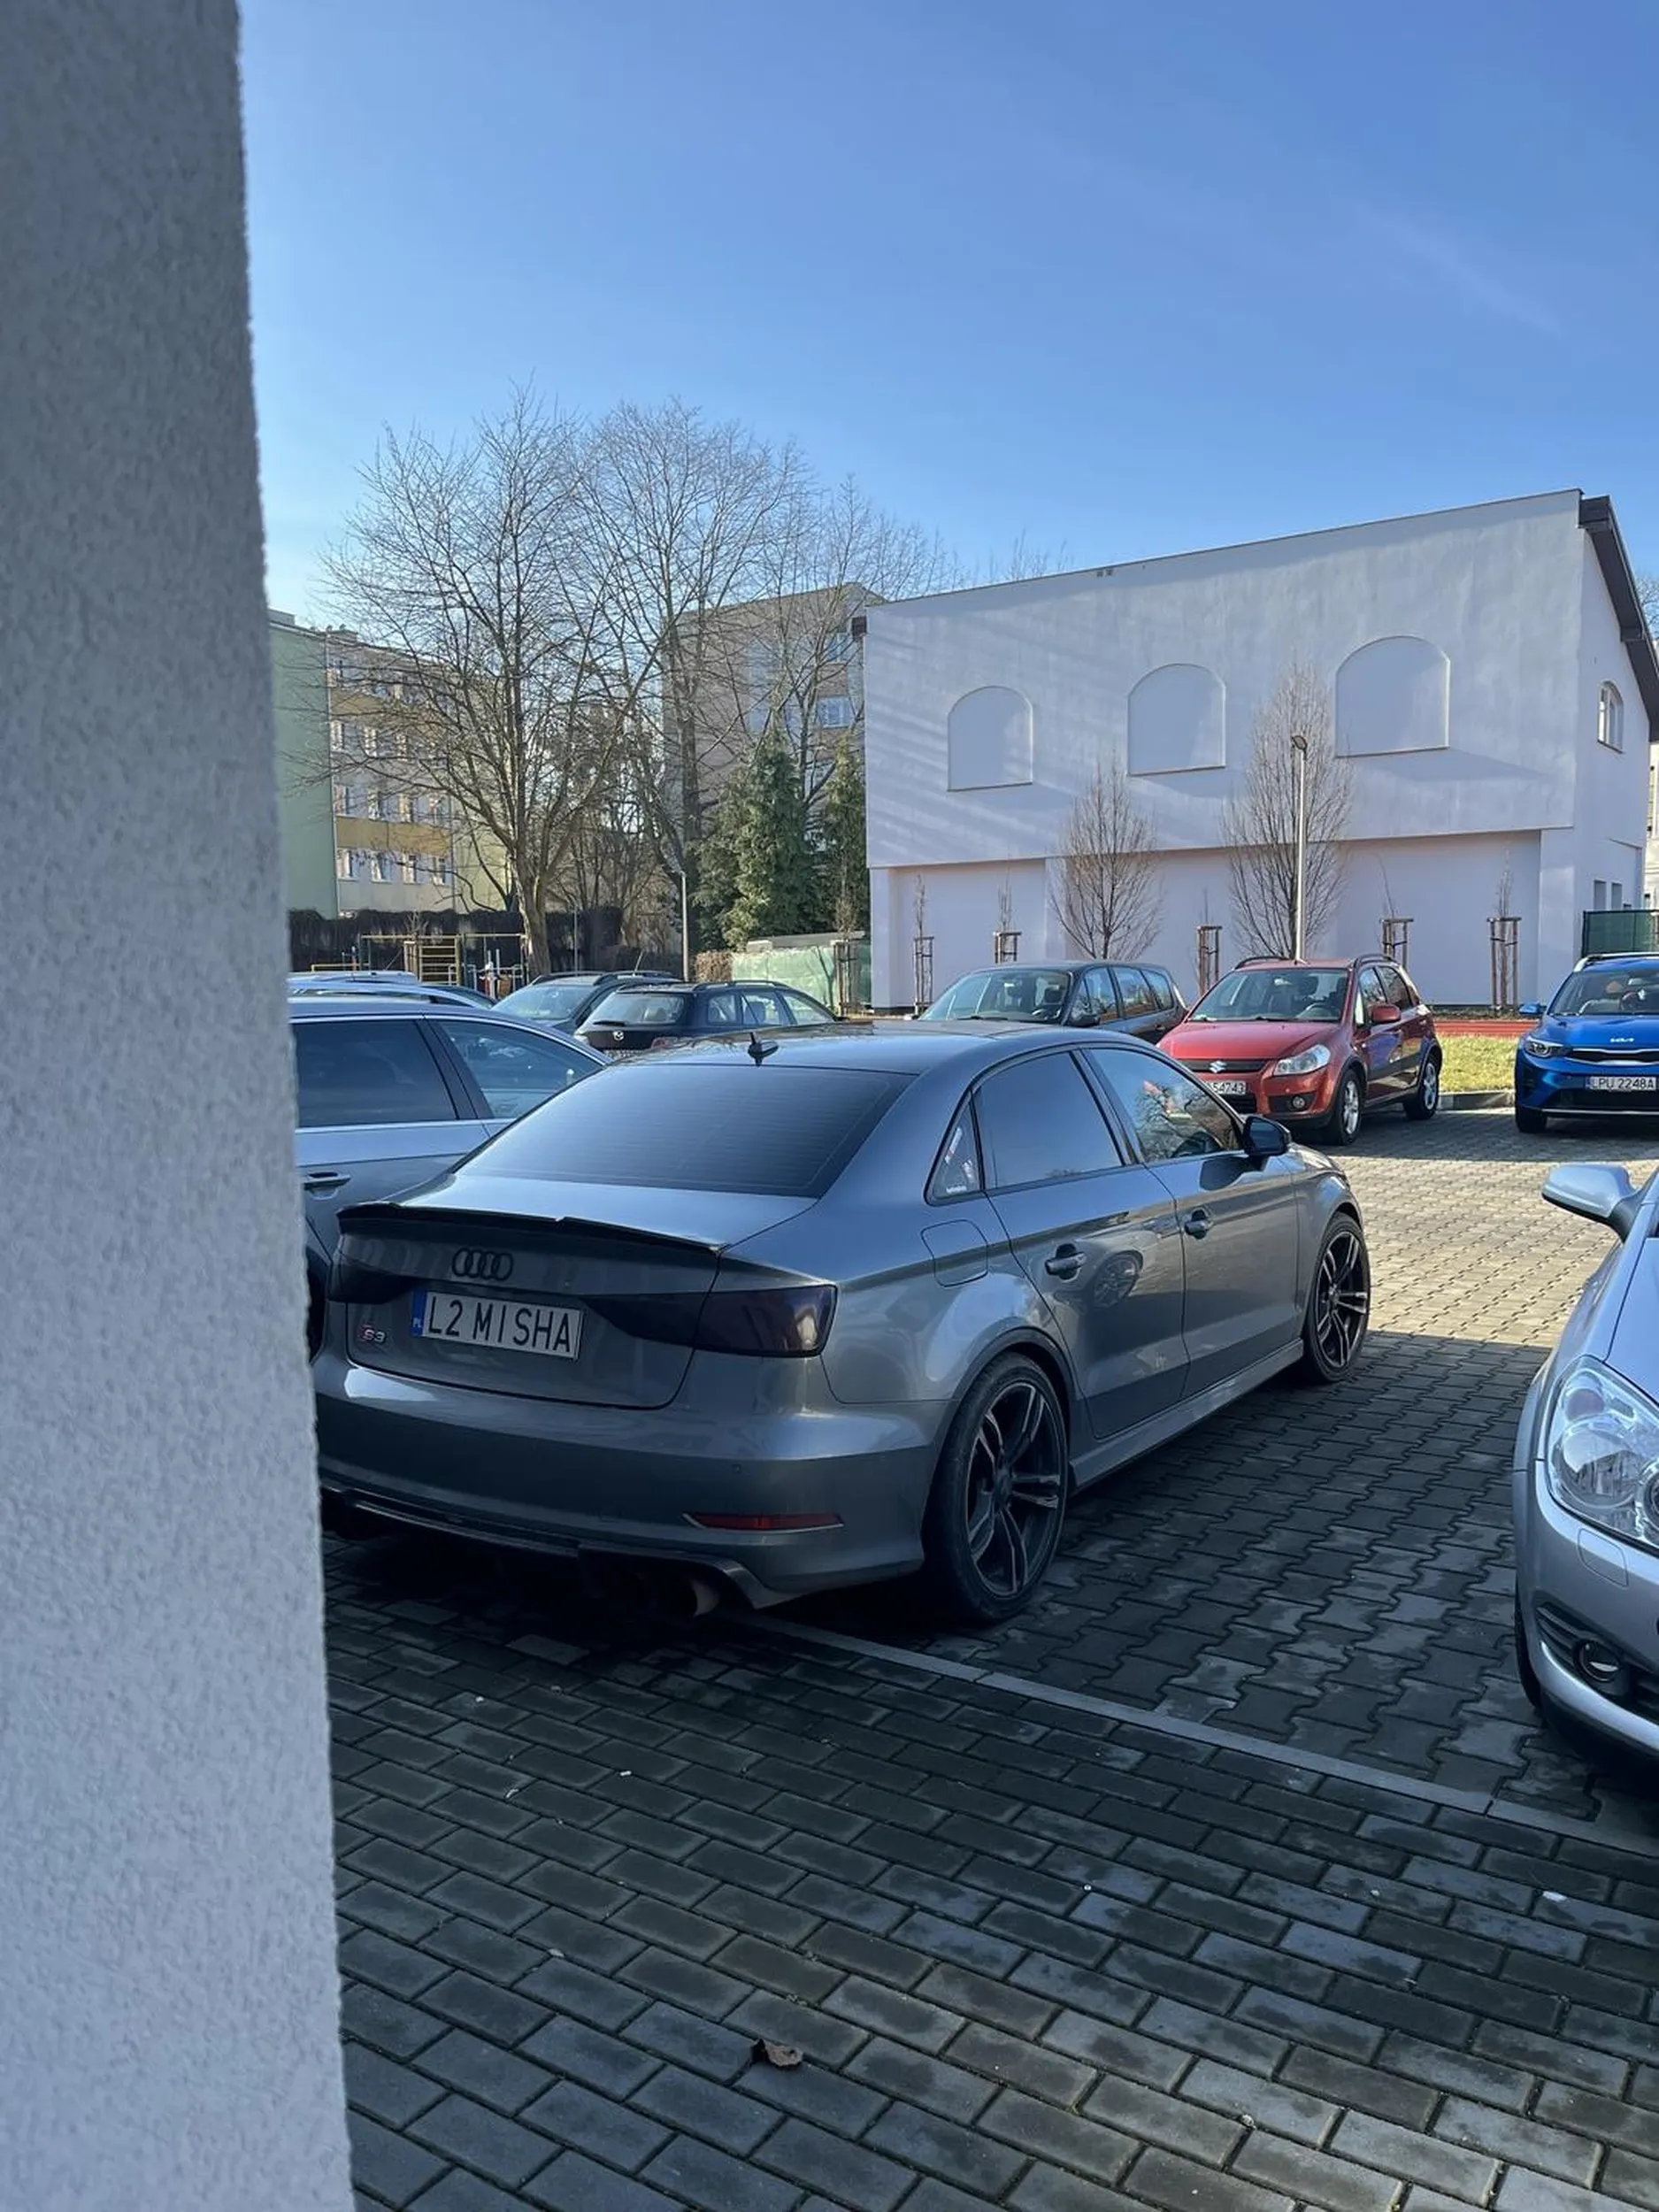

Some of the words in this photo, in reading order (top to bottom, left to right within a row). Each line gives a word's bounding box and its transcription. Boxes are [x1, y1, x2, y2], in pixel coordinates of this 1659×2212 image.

[1592, 1078, 1614, 1088] LPU
[1617, 1078, 1655, 1089] 2248A
[427, 1295, 464, 1336] L2
[472, 1302, 571, 1353] MISHA
[365, 1329, 386, 1343] S3
